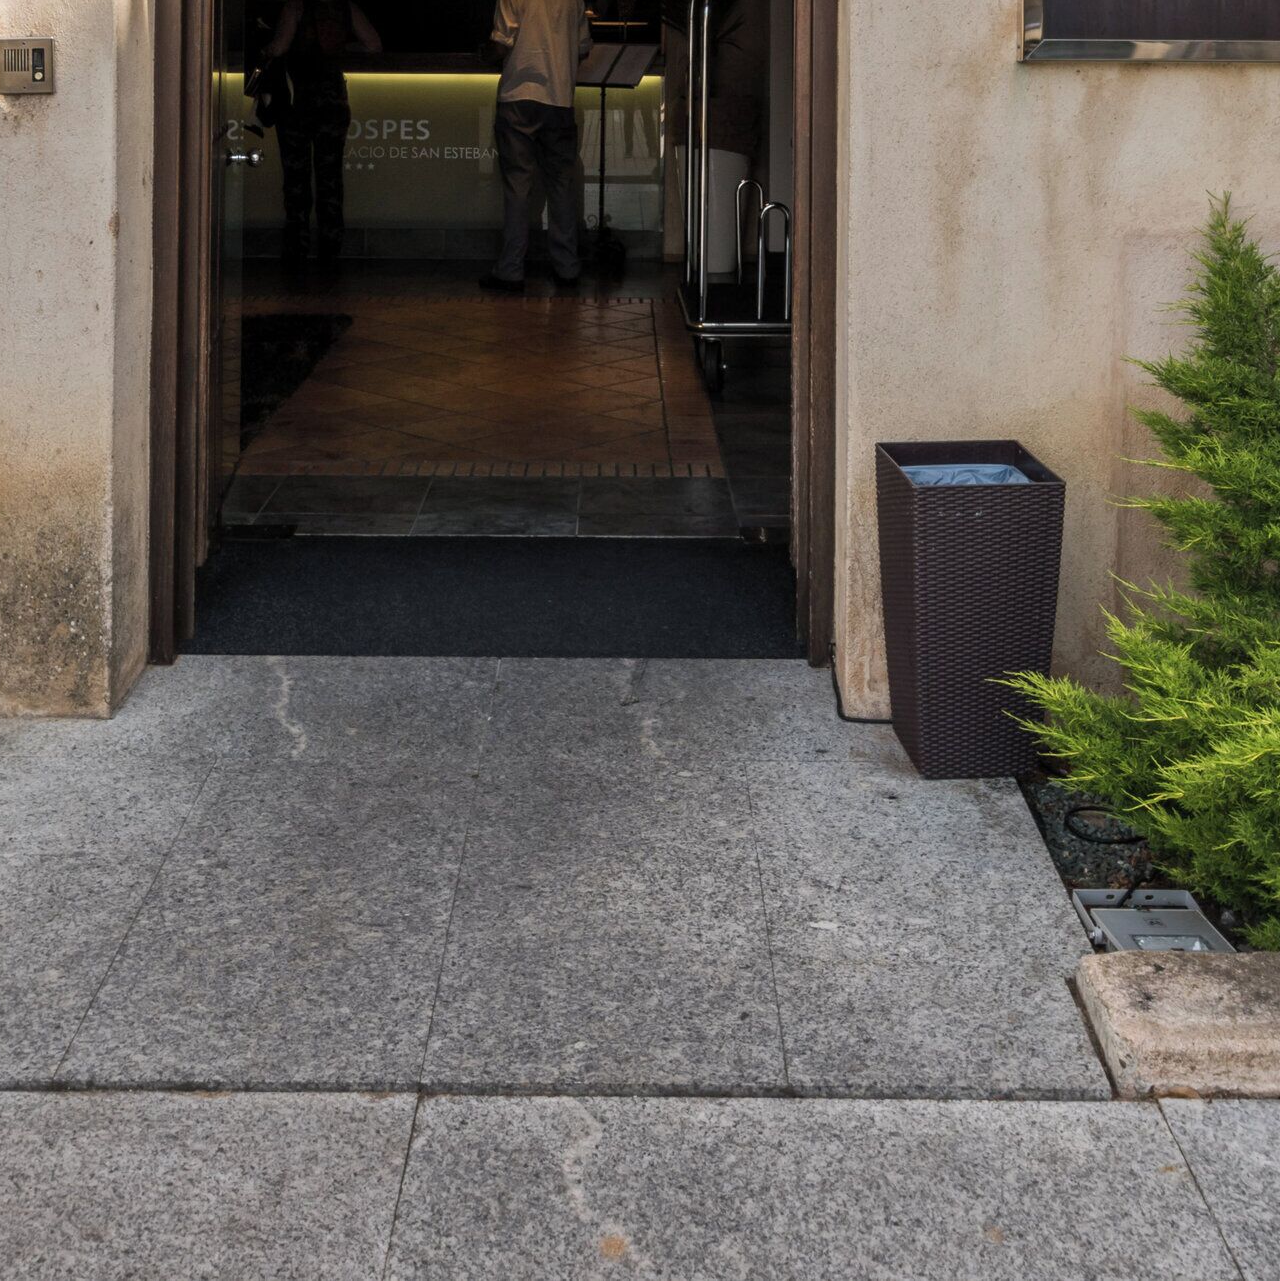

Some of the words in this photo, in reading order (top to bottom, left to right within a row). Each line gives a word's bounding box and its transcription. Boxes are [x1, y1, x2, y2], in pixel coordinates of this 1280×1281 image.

[344, 145, 385, 159] ACIO
[389, 146, 408, 159] DE
[411, 146, 440, 159] SAN
